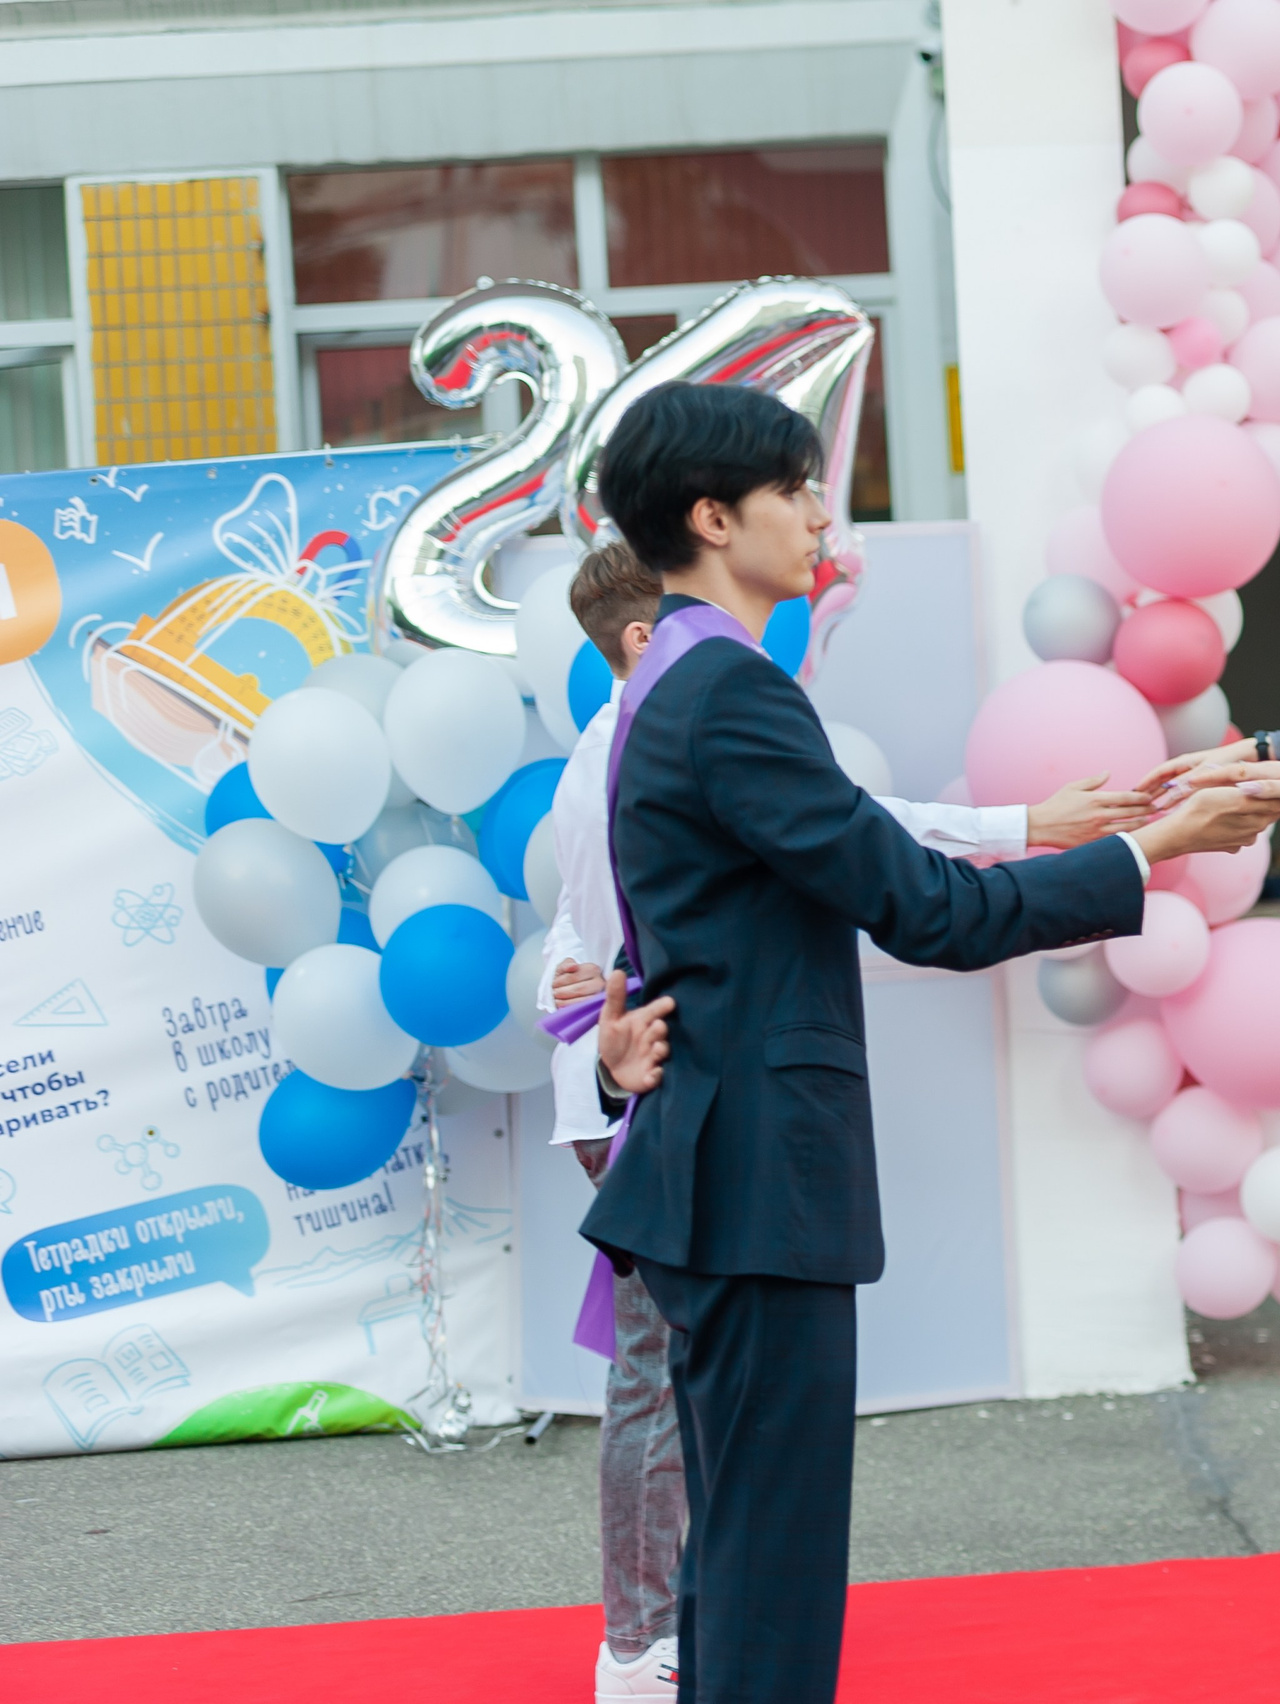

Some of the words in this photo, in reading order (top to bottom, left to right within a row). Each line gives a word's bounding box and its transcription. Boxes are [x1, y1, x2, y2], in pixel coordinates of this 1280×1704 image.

[162, 996, 248, 1038] Завтра
[172, 1040, 188, 1072] в
[196, 1027, 271, 1066] школу
[1, 1071, 85, 1102] чтобы
[184, 1086, 197, 1108] с
[293, 1180, 396, 1237] тишина!
[24, 1225, 131, 1275] Тетрадки
[135, 1196, 245, 1243] открыли,
[39, 1282, 86, 1322] рты
[89, 1250, 196, 1298] закрыли
